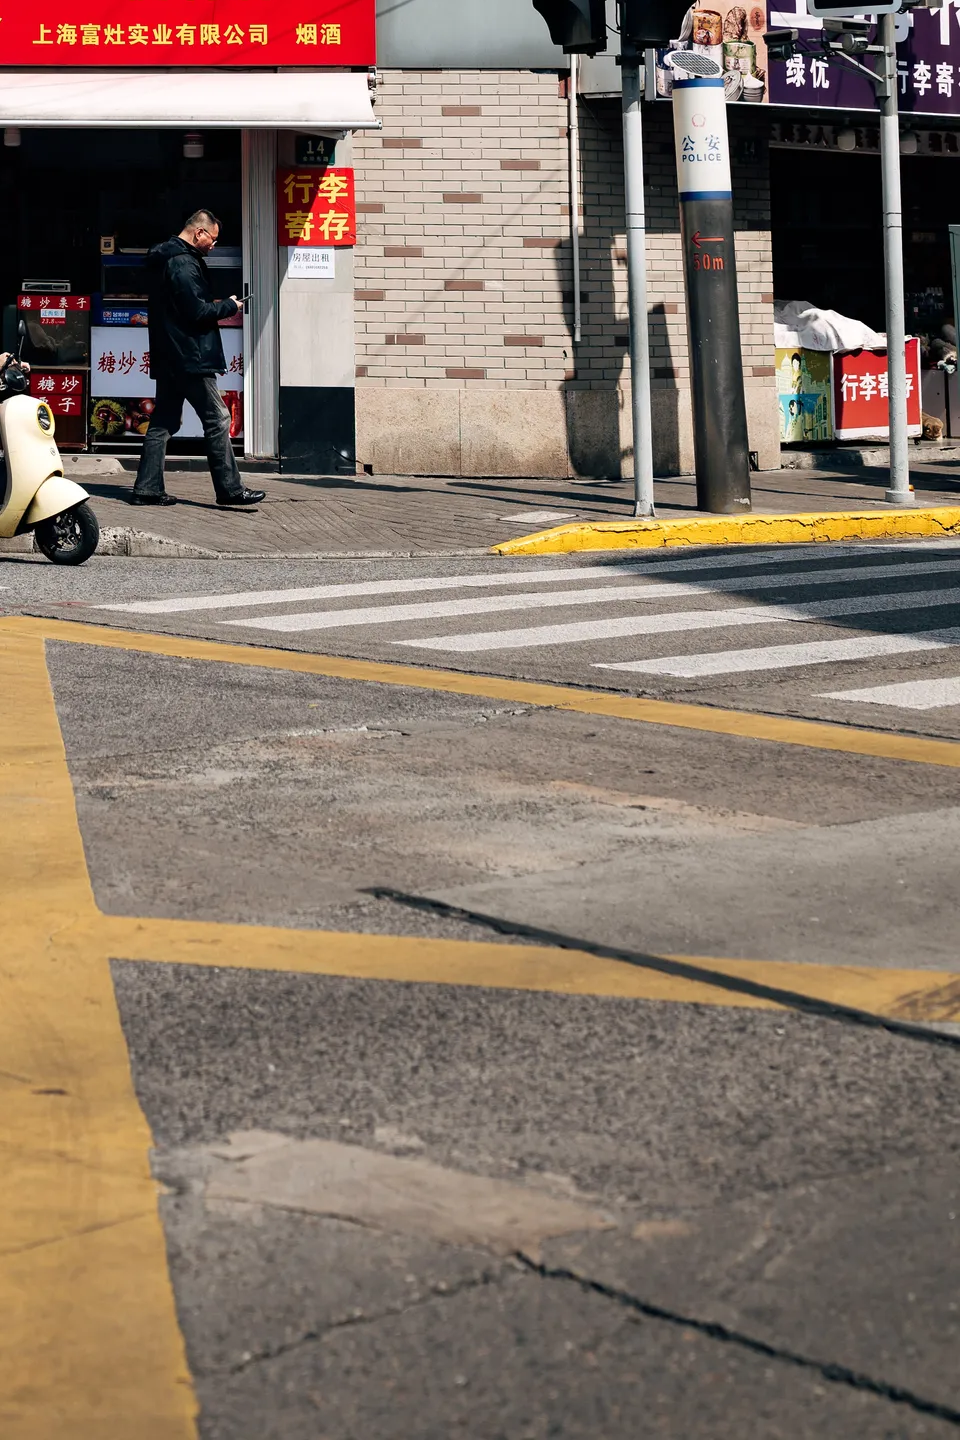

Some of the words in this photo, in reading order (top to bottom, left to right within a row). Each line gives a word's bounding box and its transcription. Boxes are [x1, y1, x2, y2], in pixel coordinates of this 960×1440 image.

[32, 22, 269, 46] 上海富灶实业有限公司
[296, 22, 341, 46] 烟酒
[306, 140, 325, 154] 14
[681, 134, 720, 152] 公安
[682, 153, 722, 163] POLICE
[283, 172, 349, 204] 行李
[284, 209, 350, 241] 寄存
[292, 252, 330, 263] 房屋出租
[693, 253, 725, 271] 50m
[36, 375, 80, 392] 糖炒
